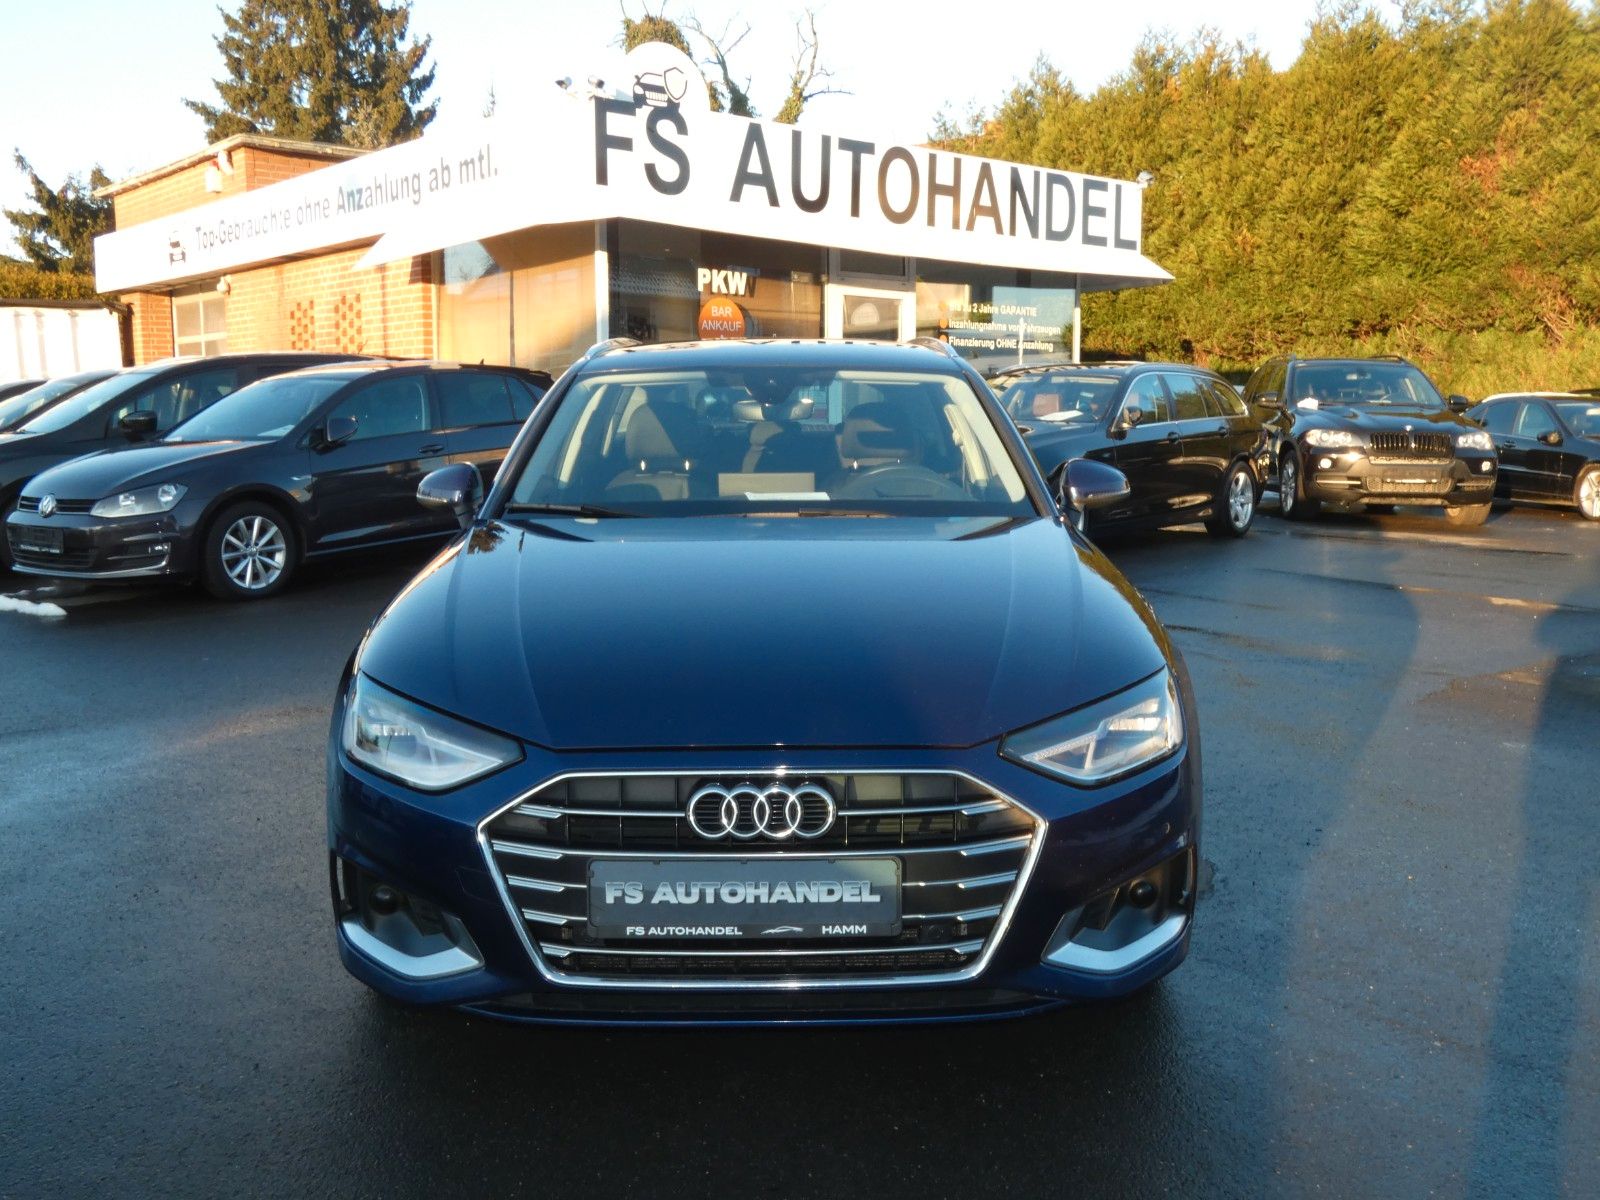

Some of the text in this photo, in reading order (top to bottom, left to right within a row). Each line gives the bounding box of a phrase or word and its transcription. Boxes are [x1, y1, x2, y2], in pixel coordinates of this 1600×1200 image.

[594, 96, 1138, 251] FS AUTOHANDEL
[296, 196, 330, 226] ohne
[336, 172, 421, 215] Anzahlung
[429, 156, 451, 192] ab
[459, 143, 499, 185] mtl.
[697, 267, 748, 296] PKW
[711, 305, 733, 318] BAR
[972, 302, 979, 313] 2
[979, 303, 999, 315] Jahre
[1000, 304, 1038, 317] GARANTIE
[701, 319, 742, 333] ANKAUF
[948, 318, 1007, 332] Inzahlungnahme
[948, 335, 995, 350] Finanzierung
[996, 338, 1018, 349] OHNE
[605, 880, 882, 904] FS AUTOHANDEL
[626, 924, 868, 937] FS AUTOHANDEL HAMM
